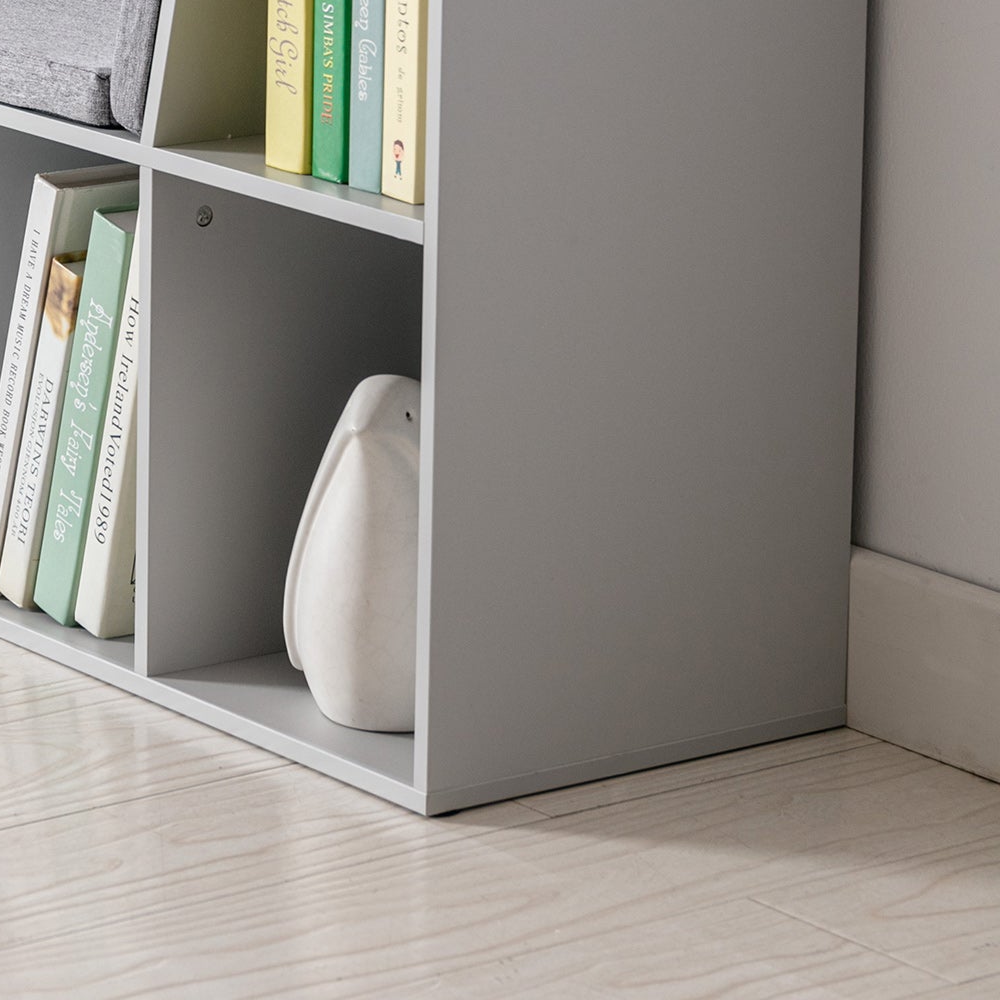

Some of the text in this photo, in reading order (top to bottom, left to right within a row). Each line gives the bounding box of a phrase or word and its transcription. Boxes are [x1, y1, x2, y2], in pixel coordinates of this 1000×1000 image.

[321, 2, 335, 69] SIMBA'S
[269, 35, 299, 96] Girl
[357, 37, 379, 102] Gables
[320, 72, 334, 127] PRIDE
[26, 238, 40, 271] HAVE
[32, 228, 41, 236] I
[25, 271, 34, 281] A
[18, 282, 32, 321] DREAM
[124, 295, 141, 349] How
[11, 323, 26, 361] MUSIC
[4, 362, 19, 407] RECORD
[0, 408, 11, 439] BOOK
[53, 296, 114, 544] Andersen's Fairy Tales
[17, 377, 55, 545] DARWINS TEORI
